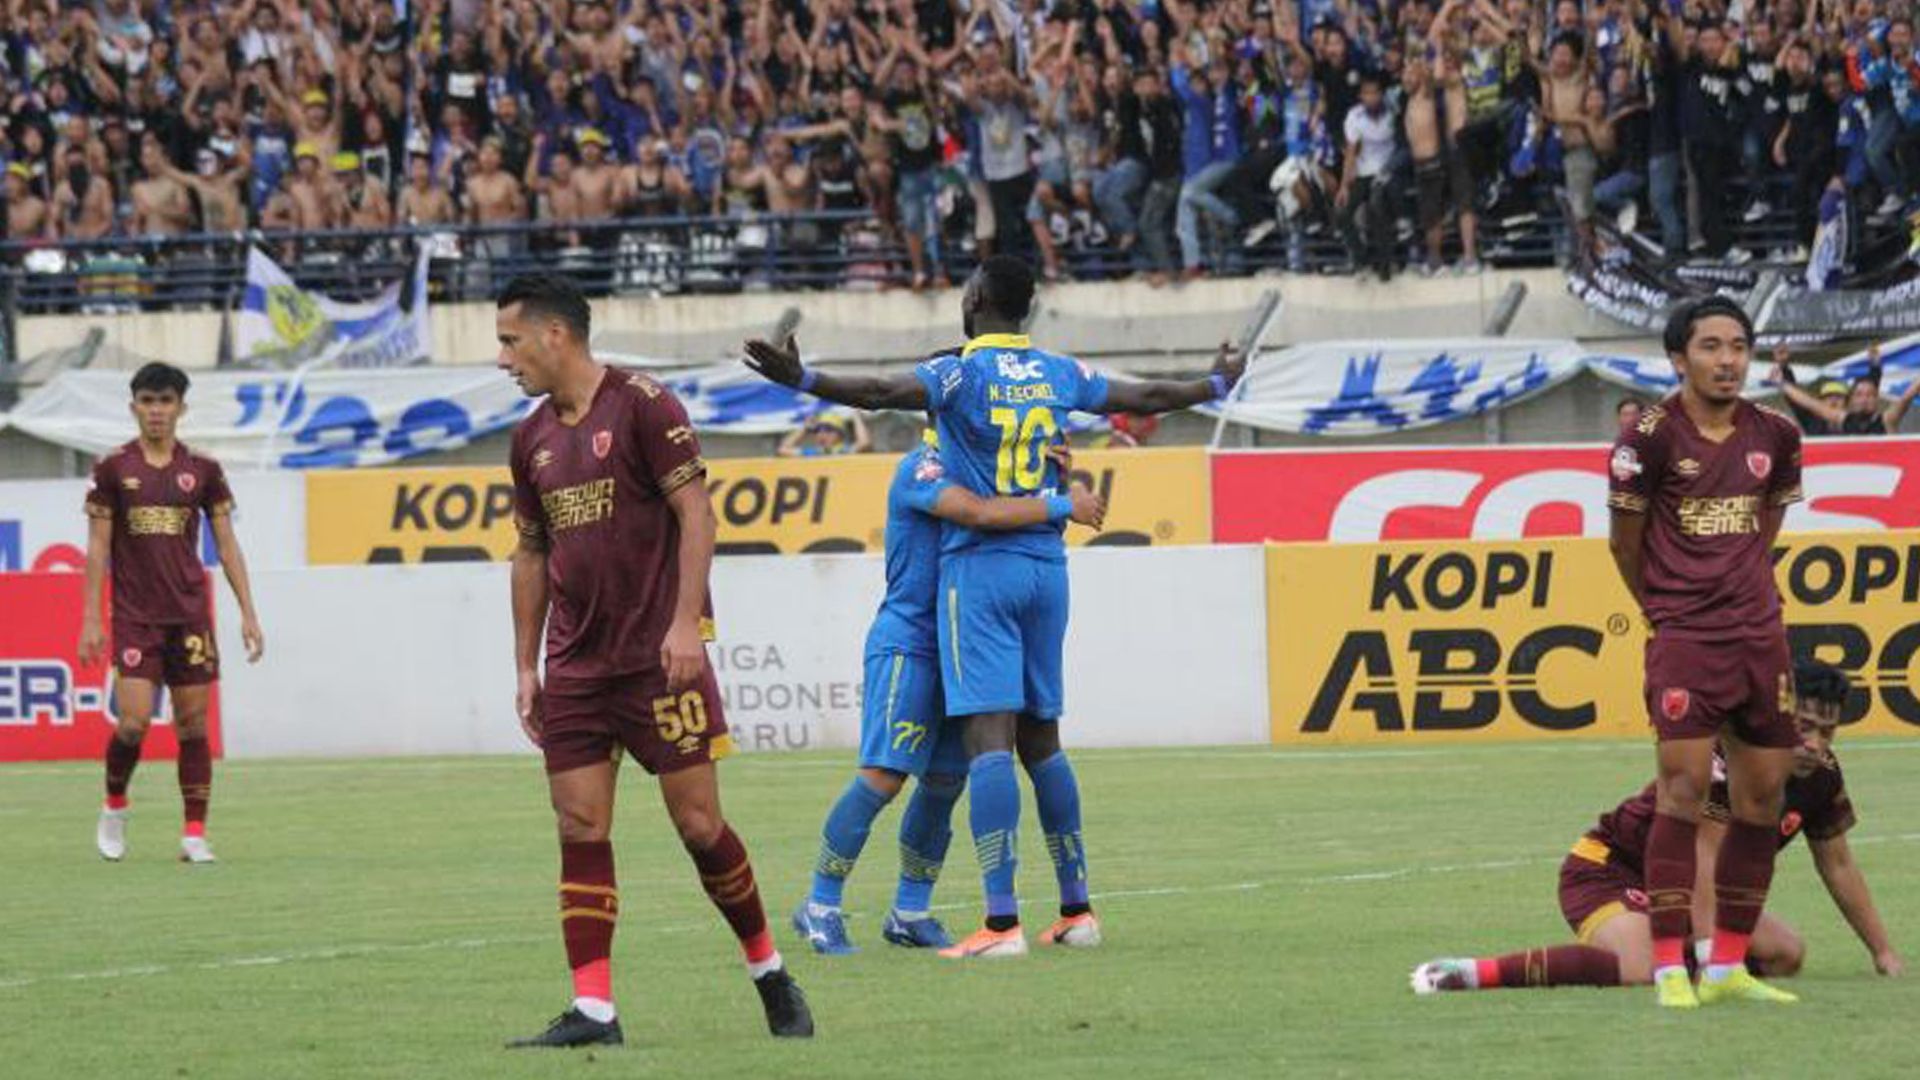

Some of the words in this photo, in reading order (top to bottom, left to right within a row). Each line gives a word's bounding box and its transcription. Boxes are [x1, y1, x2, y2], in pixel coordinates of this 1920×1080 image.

[991, 407, 1057, 494] 10
[391, 484, 513, 531] KOP
[712, 476, 829, 526] OPI
[1370, 550, 1552, 611] KOPI
[1772, 544, 1920, 604] OPI
[719, 644, 785, 672] IGA
[1301, 625, 1603, 732] ABC
[653, 690, 708, 741] 50
[893, 722, 926, 751] 77
